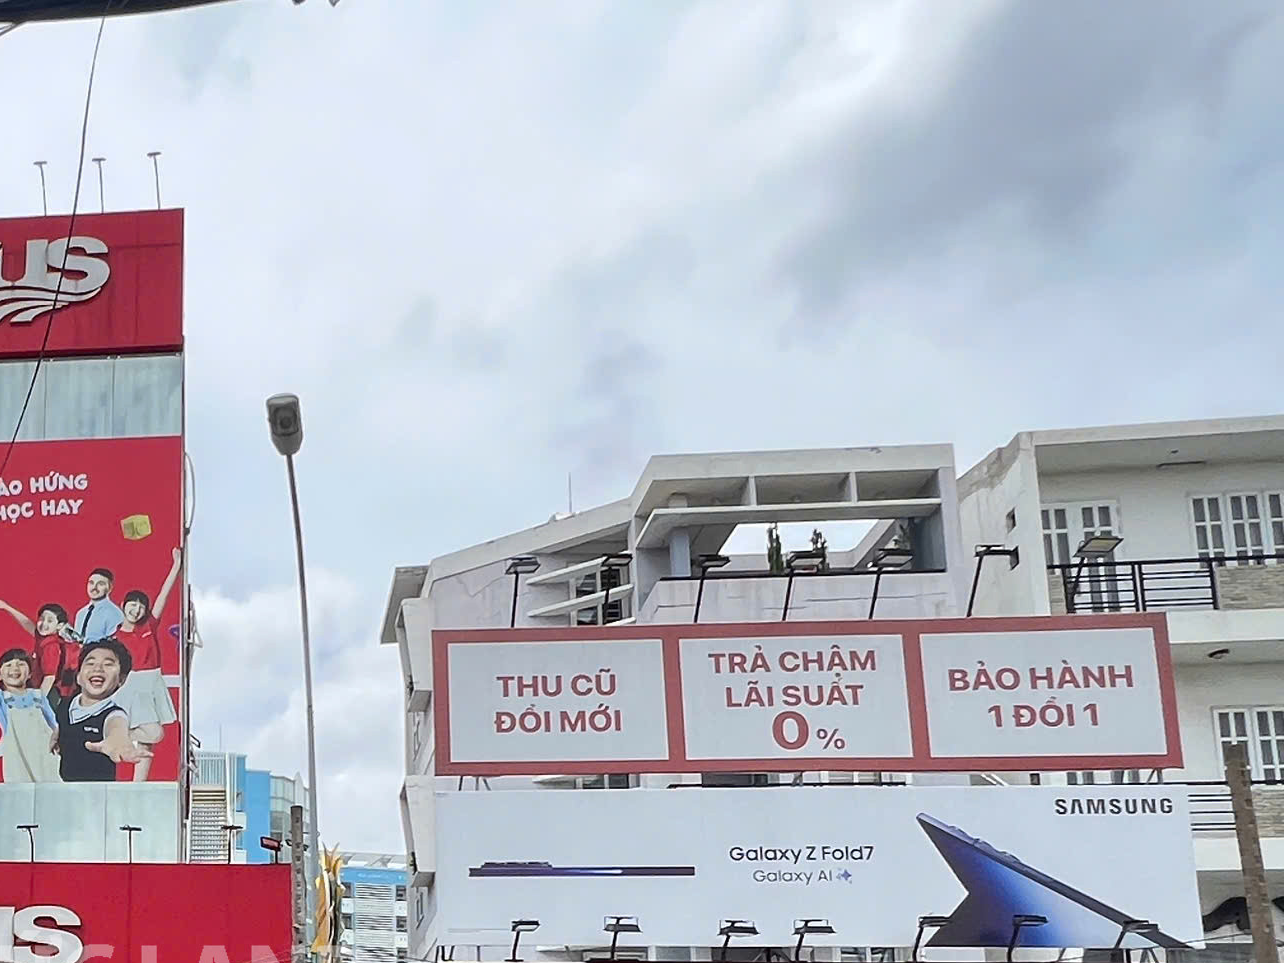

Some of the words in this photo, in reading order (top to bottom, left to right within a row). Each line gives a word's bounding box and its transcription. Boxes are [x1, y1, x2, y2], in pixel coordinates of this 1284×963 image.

[30, 471, 88, 494] HỨNG
[41, 499, 84, 516] HAY
[708, 644, 771, 674] TRẢ
[496, 675, 563, 698] THU
[570, 668, 616, 697] CŨ
[948, 660, 1020, 692] BẢO
[1029, 659, 1134, 690] HÀNH
[725, 680, 774, 708] LÃI
[494, 704, 551, 733] ĐỔI
[560, 703, 621, 733] MỚI
[988, 704, 1004, 728] 1
[1012, 696, 1075, 728] ĐỔI
[1083, 703, 1099, 726] 1
[1055, 798, 1173, 815] SAMSUNG
[729, 846, 802, 864] Galaxy
[806, 846, 817, 860] Z
[822, 846, 874, 861] Fold7
[753, 869, 813, 885] Galaxy
[818, 869, 833, 882] AI
